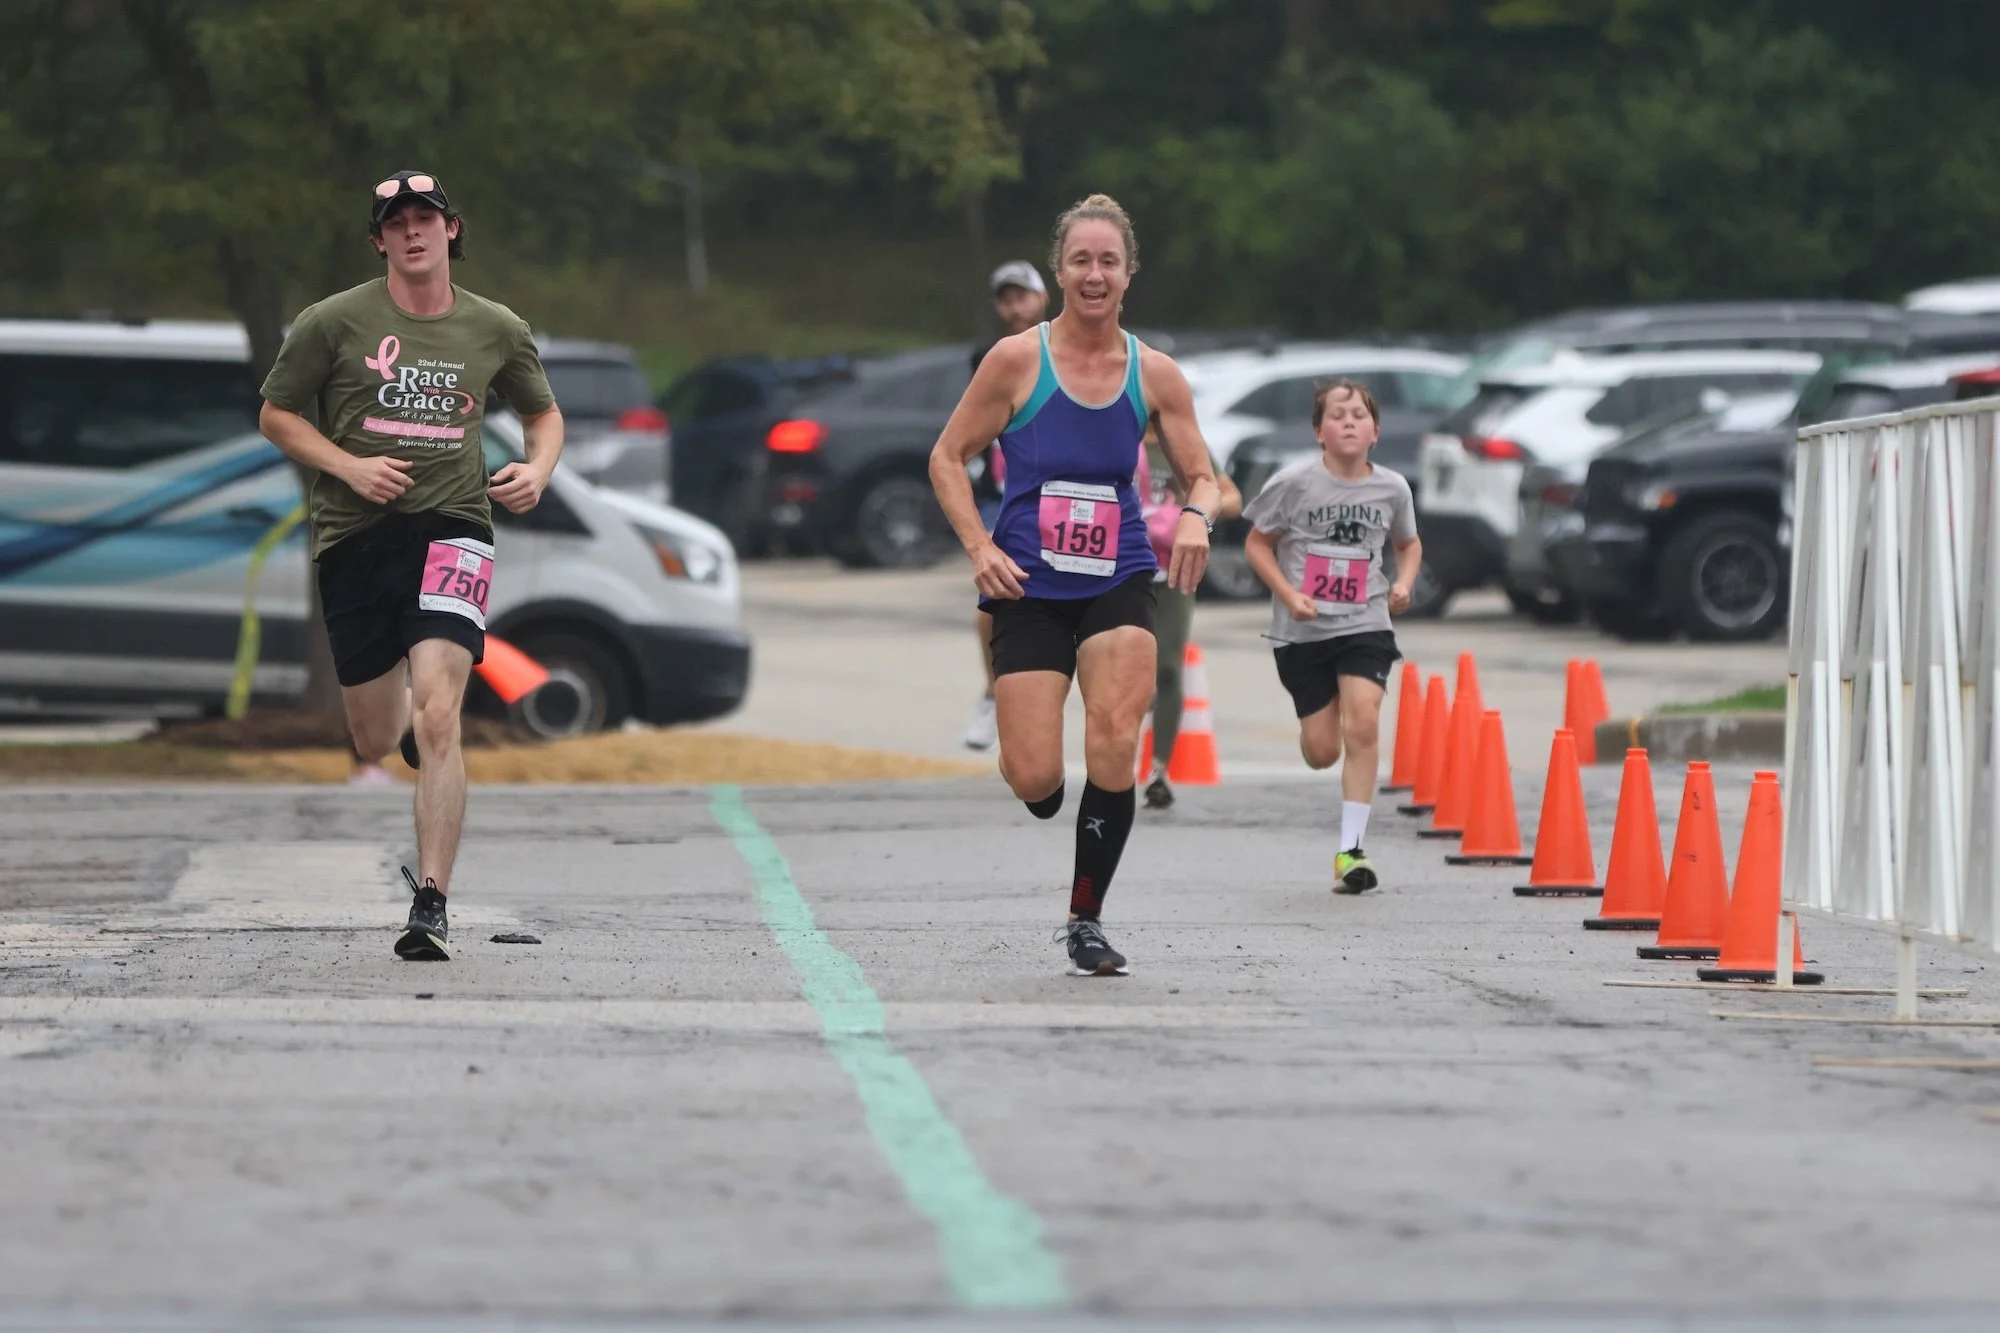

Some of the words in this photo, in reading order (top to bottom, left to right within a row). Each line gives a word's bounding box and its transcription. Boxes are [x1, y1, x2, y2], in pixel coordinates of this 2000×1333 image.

[418, 359, 436, 367] 22nd
[438, 360, 465, 370] Annual
[398, 366, 457, 393] Race
[378, 382, 455, 412] Grace
[400, 410, 411, 419] 5K
[420, 412, 434, 420] Fun
[435, 413, 451, 422] Walk
[397, 438, 436, 448] September
[436, 441, 447, 449] 20,
[1308, 504, 1384, 527] MEDINA
[1054, 521, 1107, 556] 159
[437, 566, 488, 607] 750
[1313, 575, 1358, 601] 245
